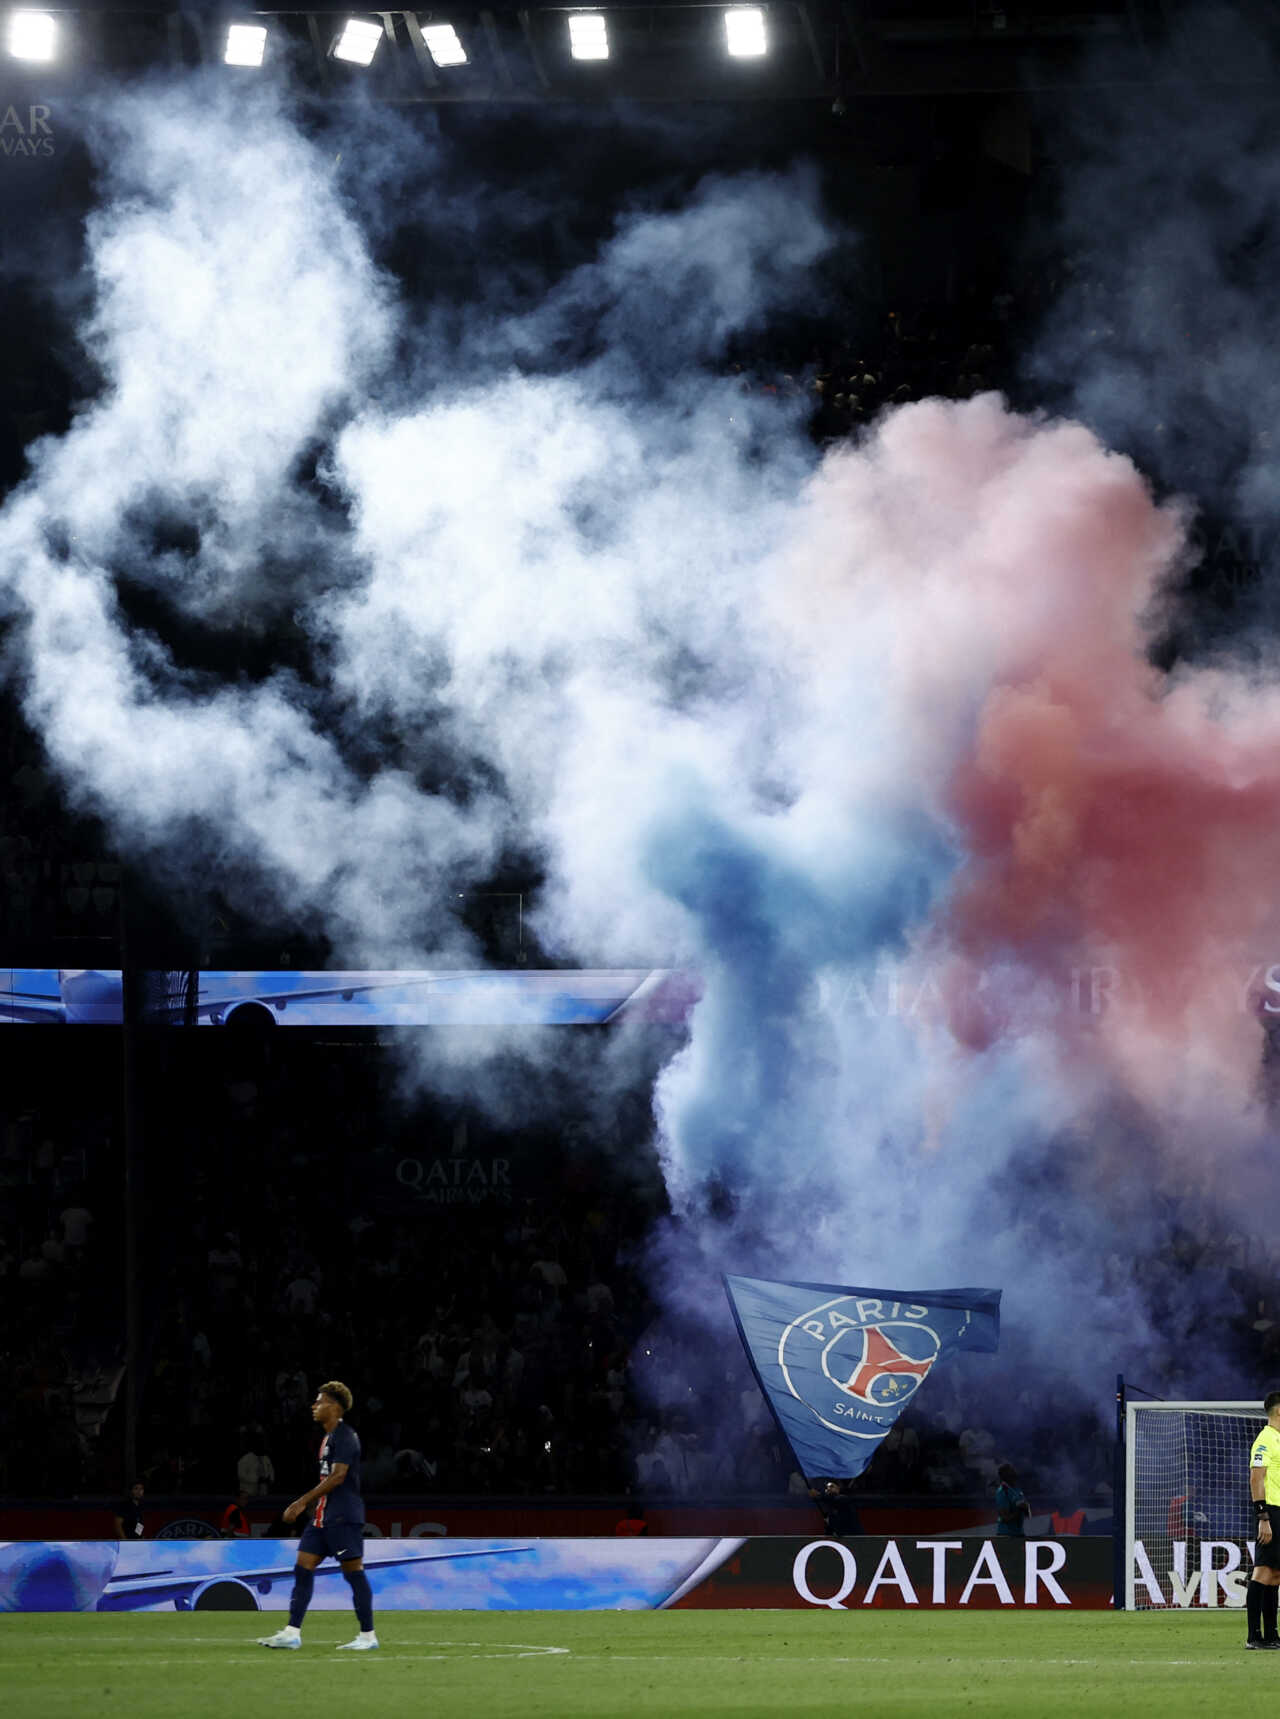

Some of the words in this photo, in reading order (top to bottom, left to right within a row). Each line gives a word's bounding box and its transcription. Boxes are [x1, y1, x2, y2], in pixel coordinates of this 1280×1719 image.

[395, 1158, 512, 1192] QATAR
[802, 1299, 929, 1342] PARIS
[792, 1540, 1072, 1609] QATAR
